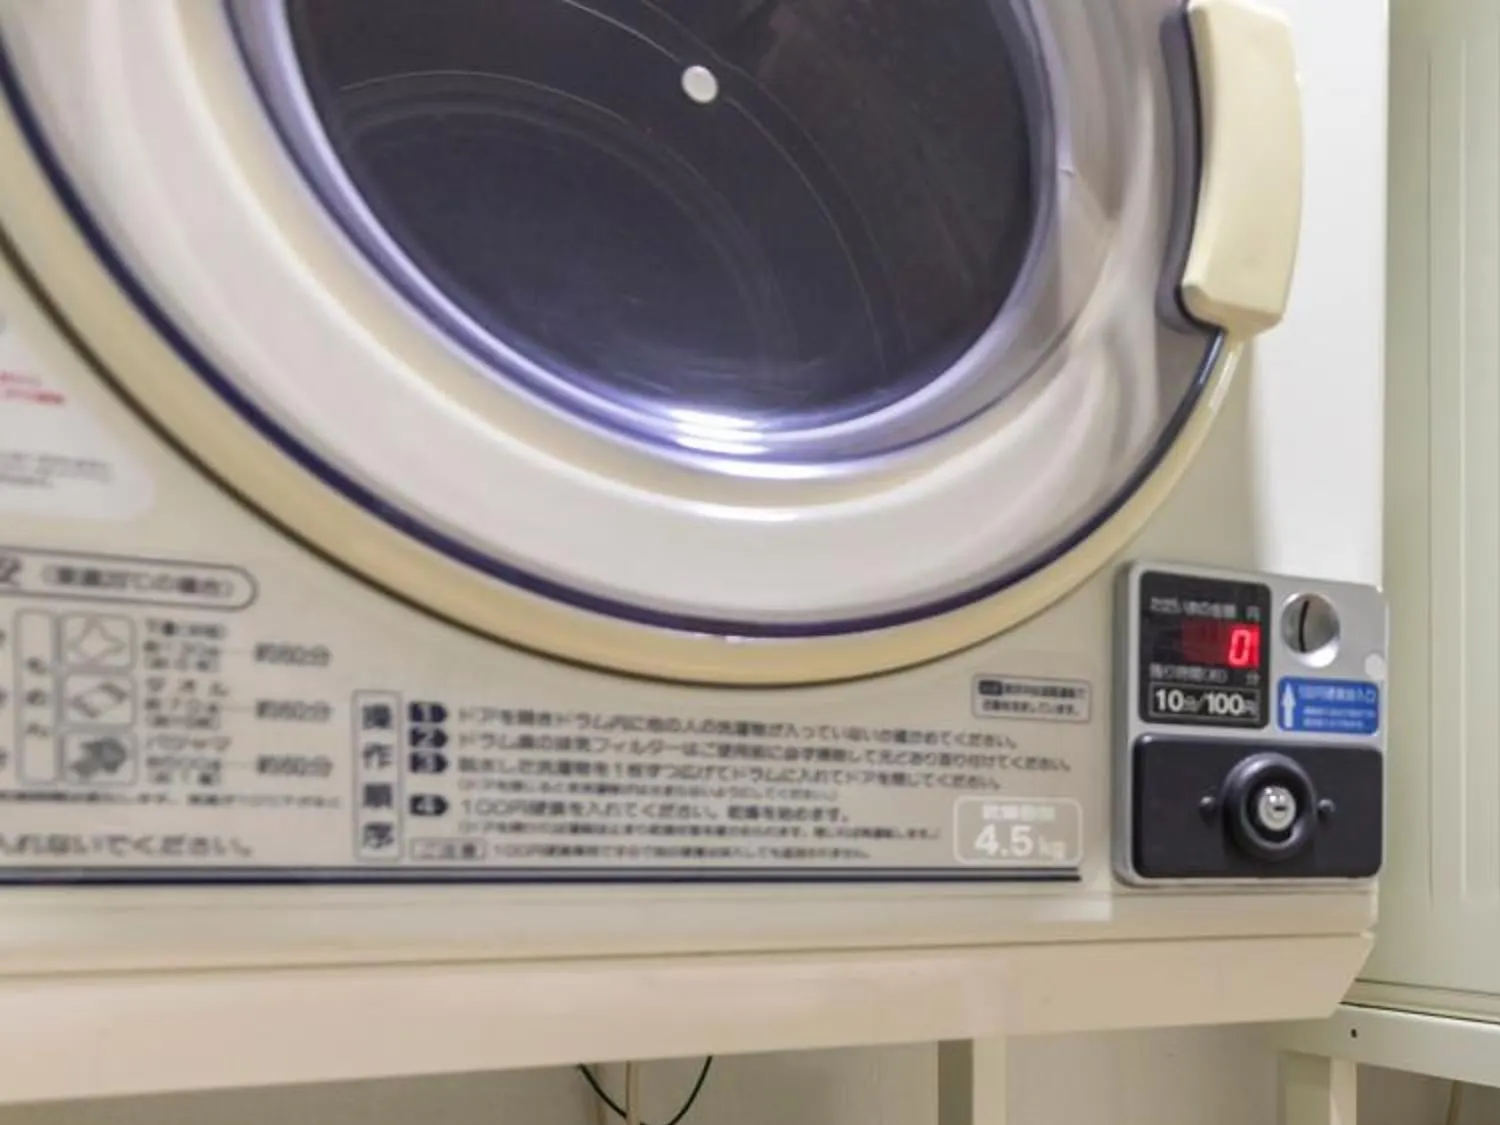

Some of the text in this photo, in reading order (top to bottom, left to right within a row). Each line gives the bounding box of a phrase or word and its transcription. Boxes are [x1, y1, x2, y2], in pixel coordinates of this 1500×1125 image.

[1228, 626, 1252, 668] 0
[362, 703, 394, 850] 操作順序
[975, 825, 1034, 857] 4.5
